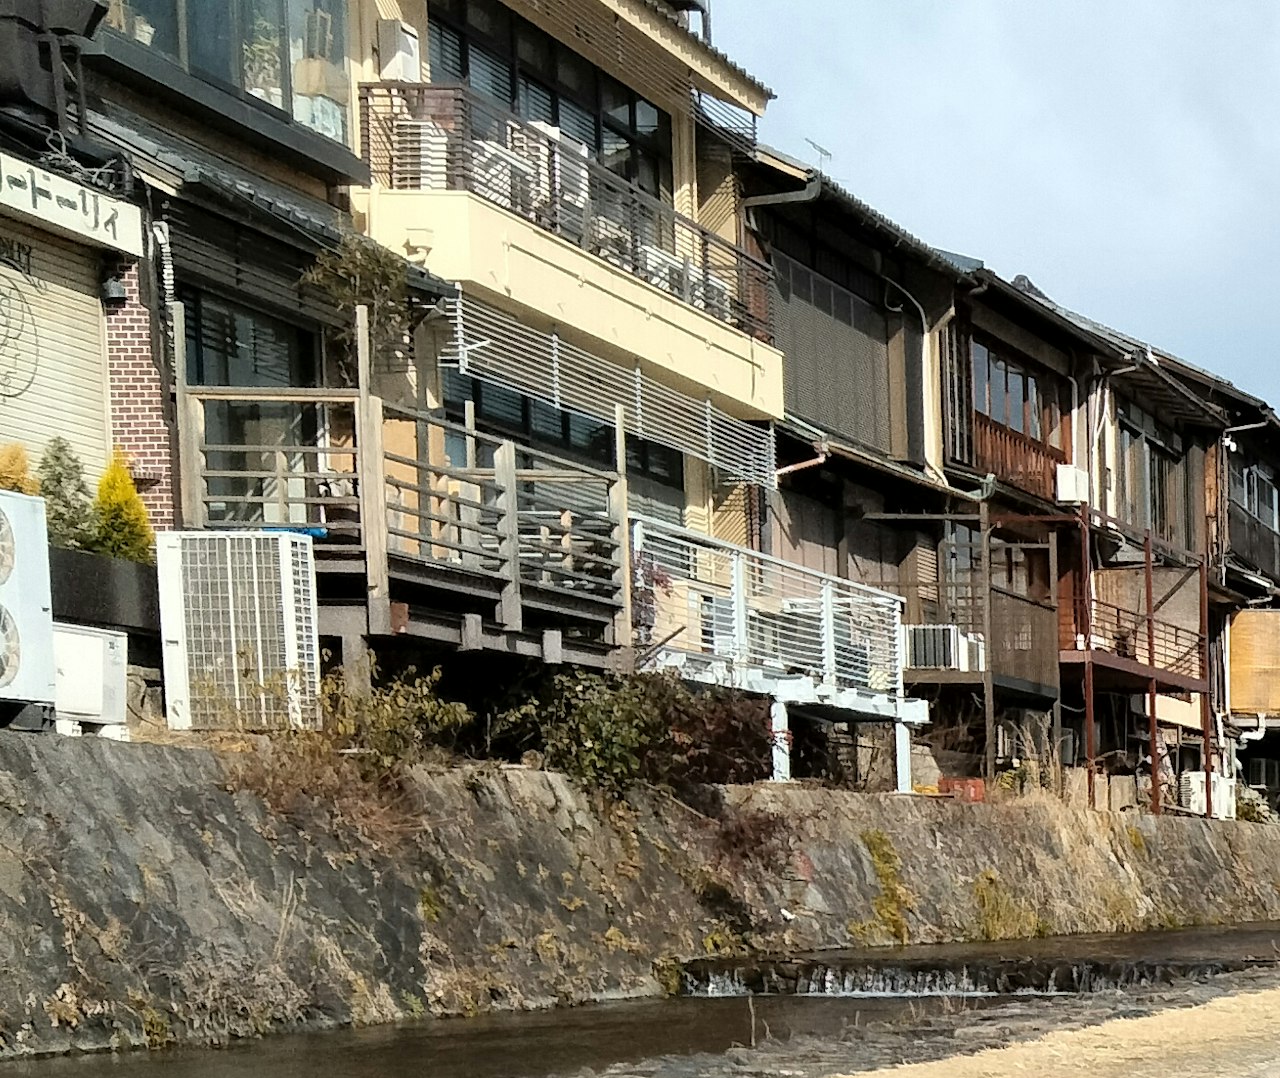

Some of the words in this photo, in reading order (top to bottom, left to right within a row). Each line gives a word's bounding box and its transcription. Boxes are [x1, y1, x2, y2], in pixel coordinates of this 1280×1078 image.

[0, 156, 119, 241] ードーリィ
